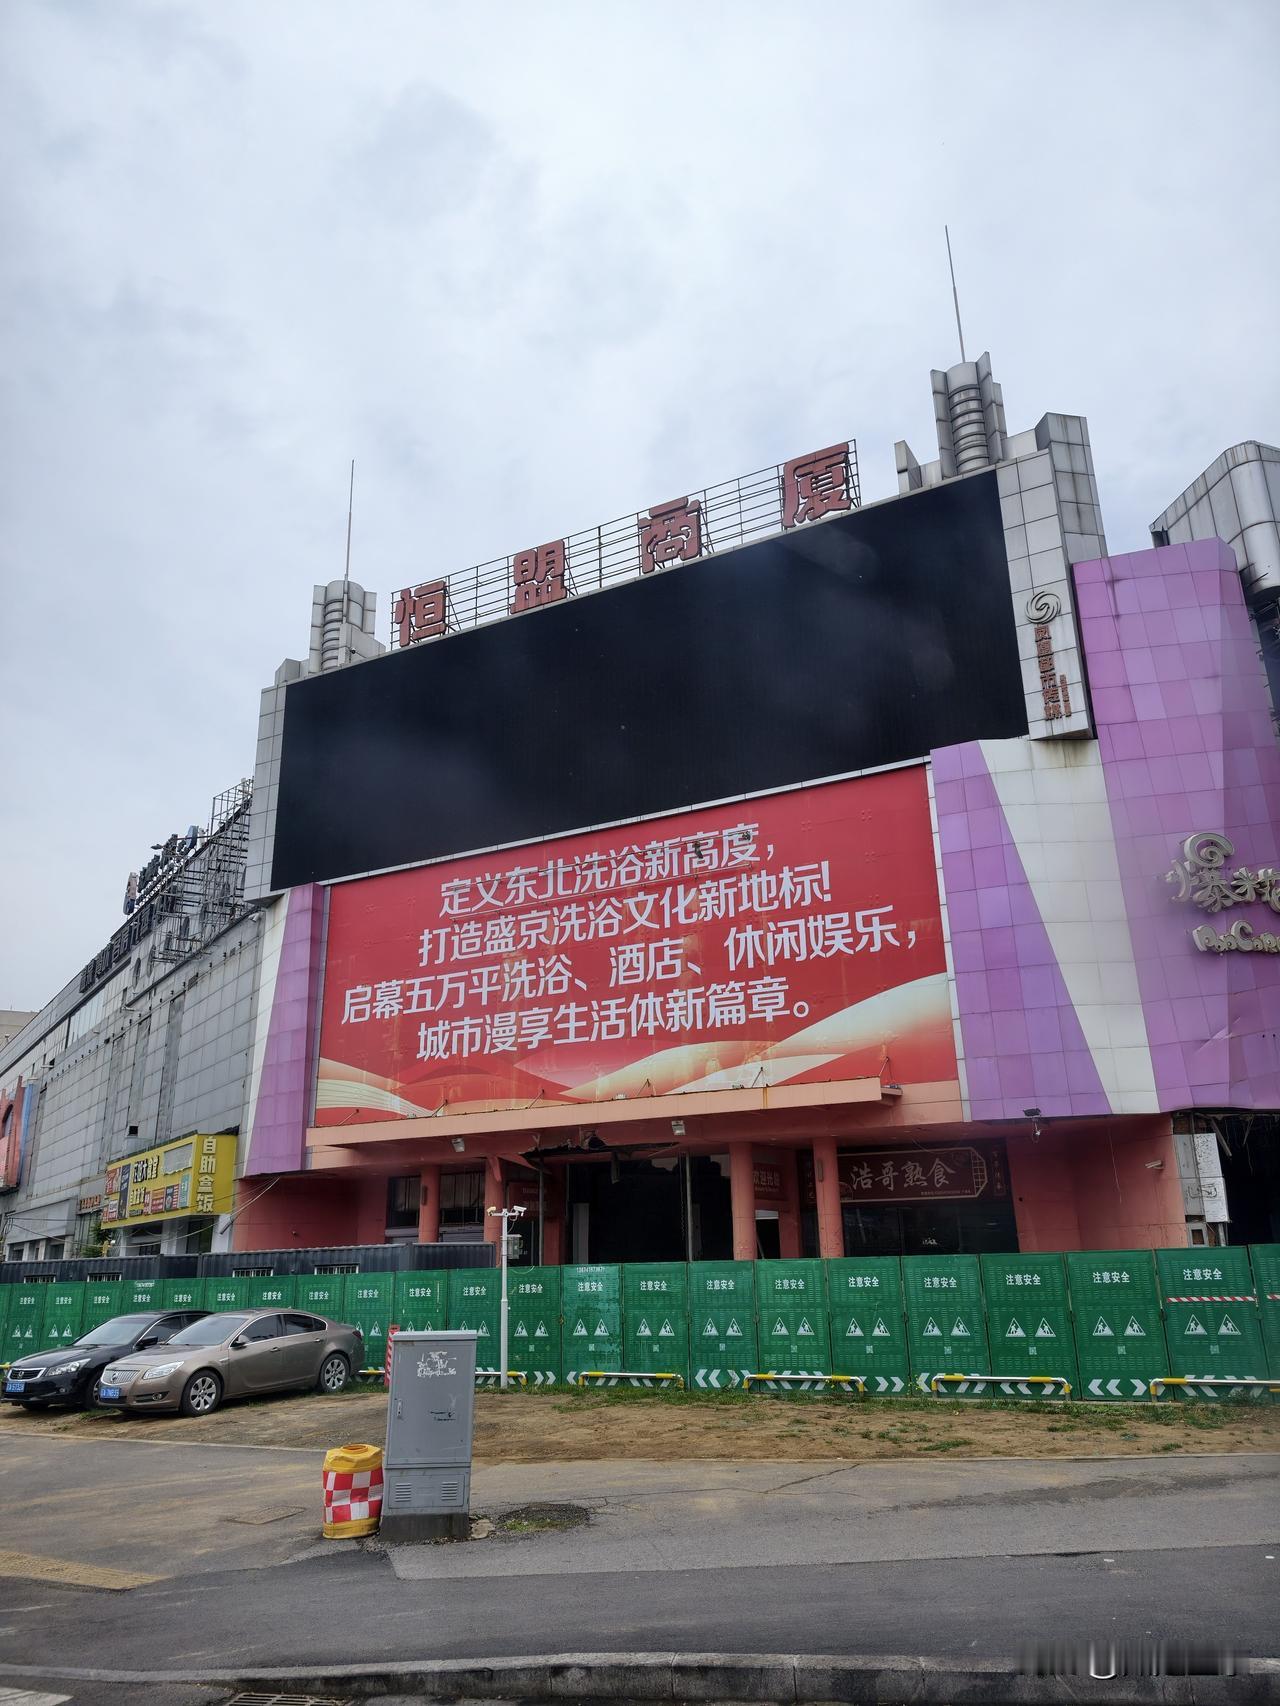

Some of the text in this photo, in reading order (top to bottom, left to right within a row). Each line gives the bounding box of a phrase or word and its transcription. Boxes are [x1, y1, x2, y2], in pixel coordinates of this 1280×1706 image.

[395, 442, 852, 647] 恒盟商厦
[439, 822, 776, 918] 定义东北洗浴新高度，
[418, 860, 832, 967] 打造盛京洗浴文化新地标！
[416, 975, 811, 1063] 城市漫享生活体新篇章。
[197, 1135, 217, 1213] 自助盒饭
[850, 1156, 956, 1192] 浩哥熟食
[1006, 1274, 1040, 1285] 注意安全
[1093, 1272, 1130, 1283] 注意安全
[1183, 1268, 1222, 1280] 注意安全
[578, 1282, 603, 1291] 注意安全
[640, 1281, 667, 1290] 注意安全
[707, 1280, 734, 1289] 注意安全
[775, 1279, 804, 1289] 注意安全
[848, 1277, 879, 1287] 注意安全
[924, 1277, 957, 1288] 注意安全
[358, 1289, 378, 1298] 注意安全
[409, 1288, 431, 1297] 注意安全
[463, 1286, 486, 1295] 注意安全
[519, 1284, 543, 1293] 注意安全
